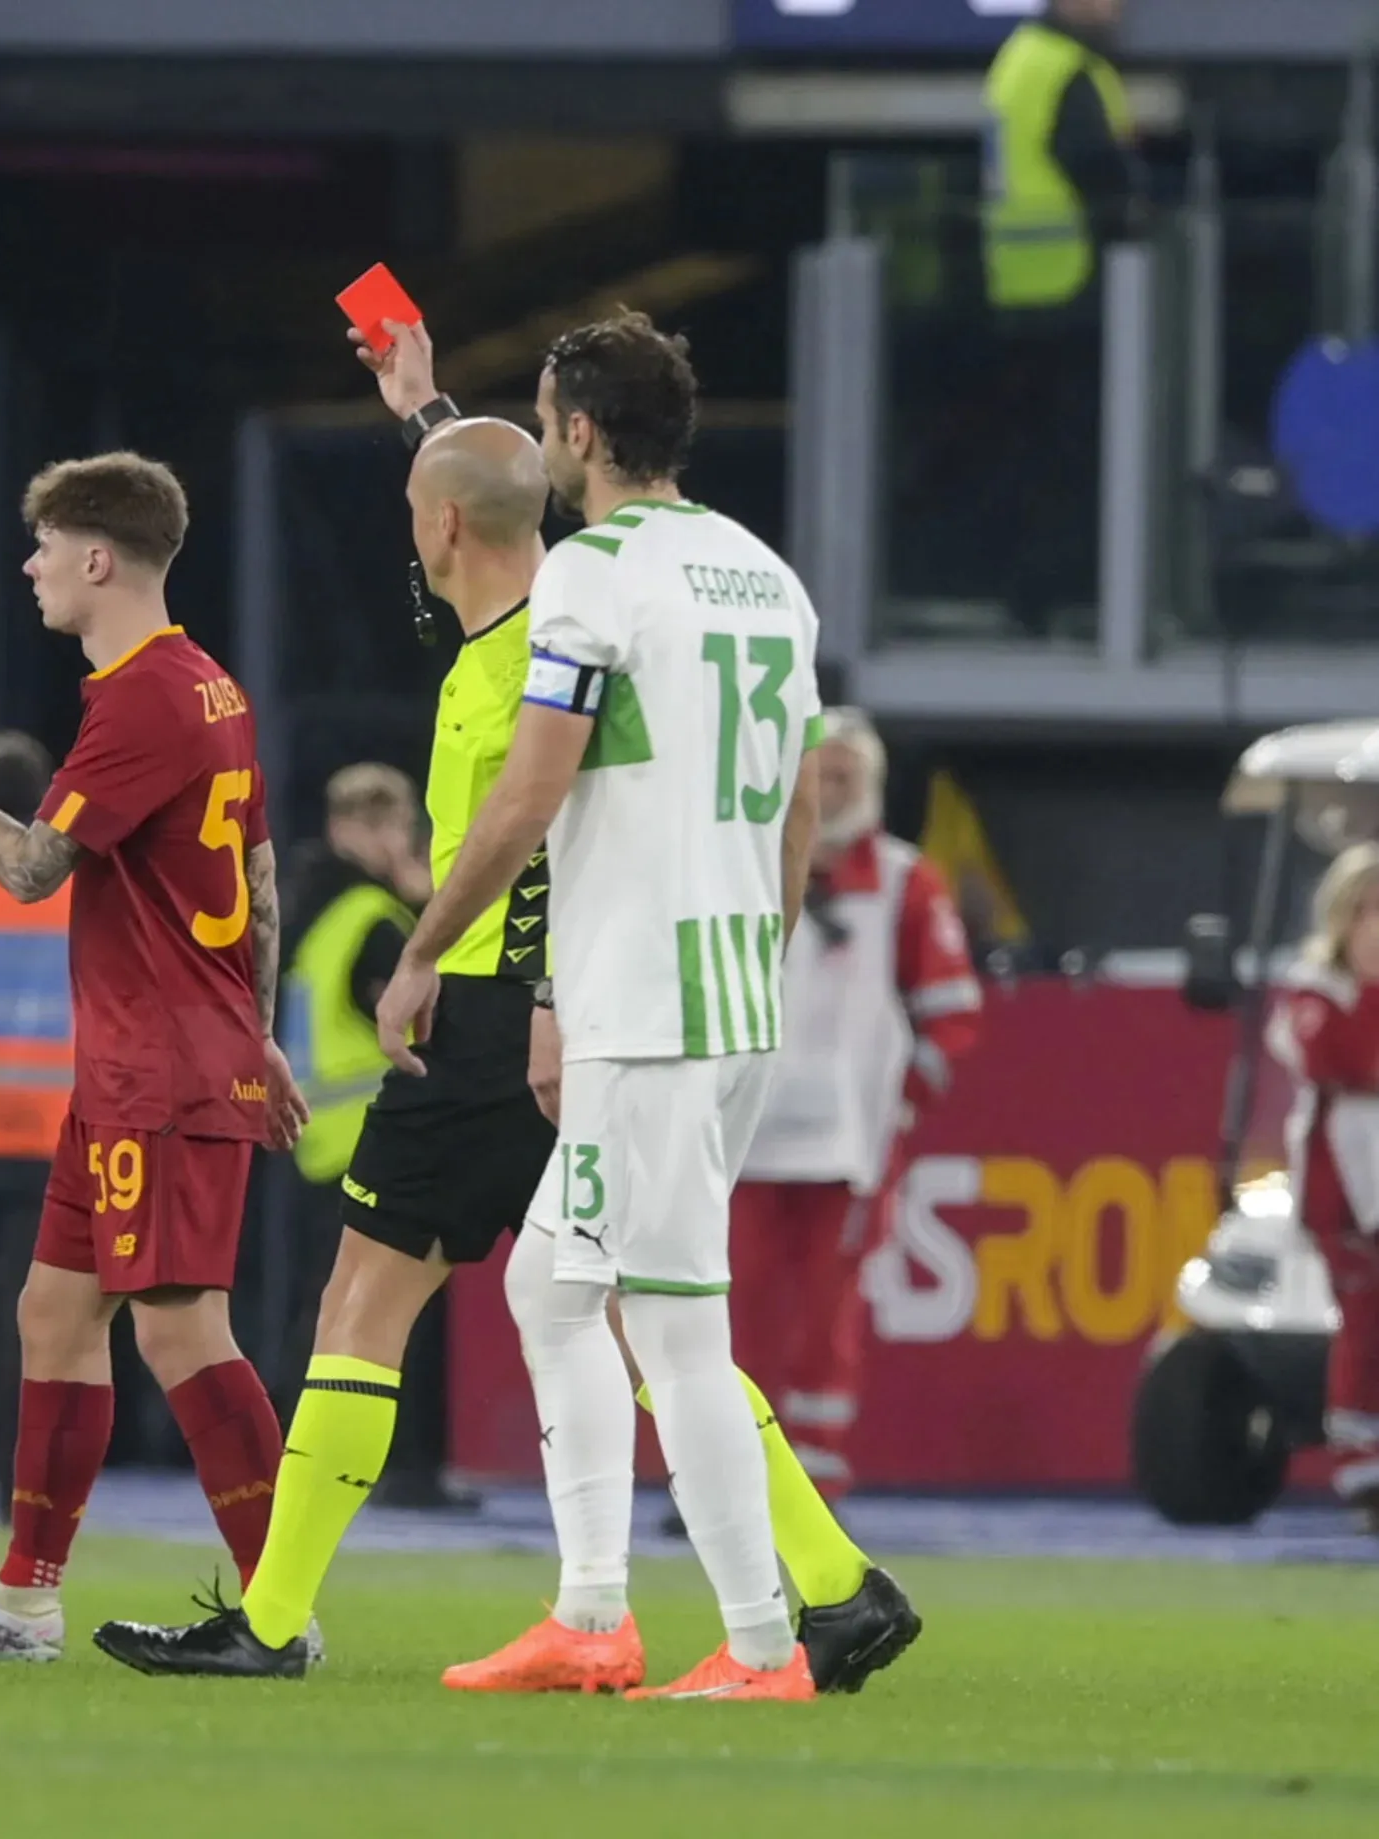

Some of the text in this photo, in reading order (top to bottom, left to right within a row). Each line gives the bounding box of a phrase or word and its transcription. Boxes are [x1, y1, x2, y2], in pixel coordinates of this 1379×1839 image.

[701, 632, 794, 824] 13
[191, 769, 252, 948] 5
[88, 1138, 143, 1214] 59
[561, 1142, 605, 1220] 13
